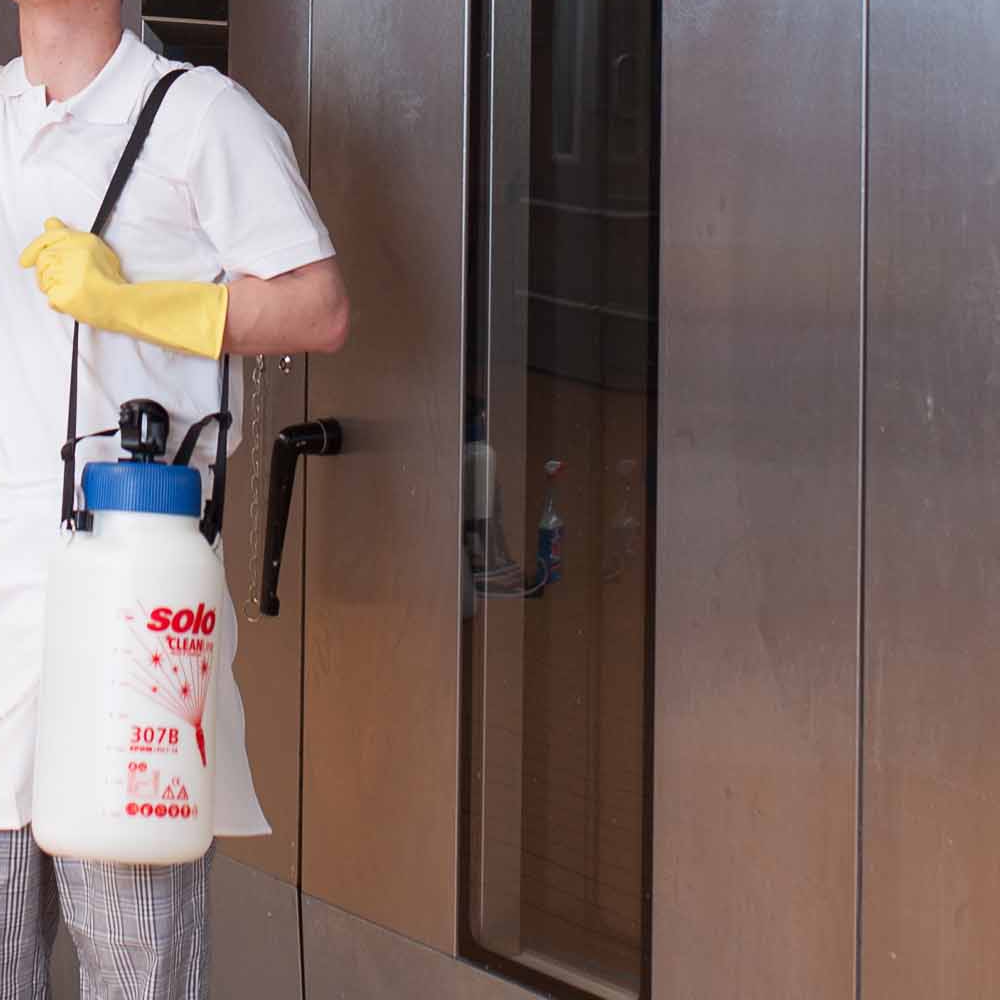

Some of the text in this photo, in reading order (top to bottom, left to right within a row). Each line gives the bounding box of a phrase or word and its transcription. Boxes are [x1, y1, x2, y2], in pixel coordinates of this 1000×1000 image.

[146, 602, 216, 635] solo
[168, 637, 203, 651] CLEAN
[130, 725, 179, 745] 307B
